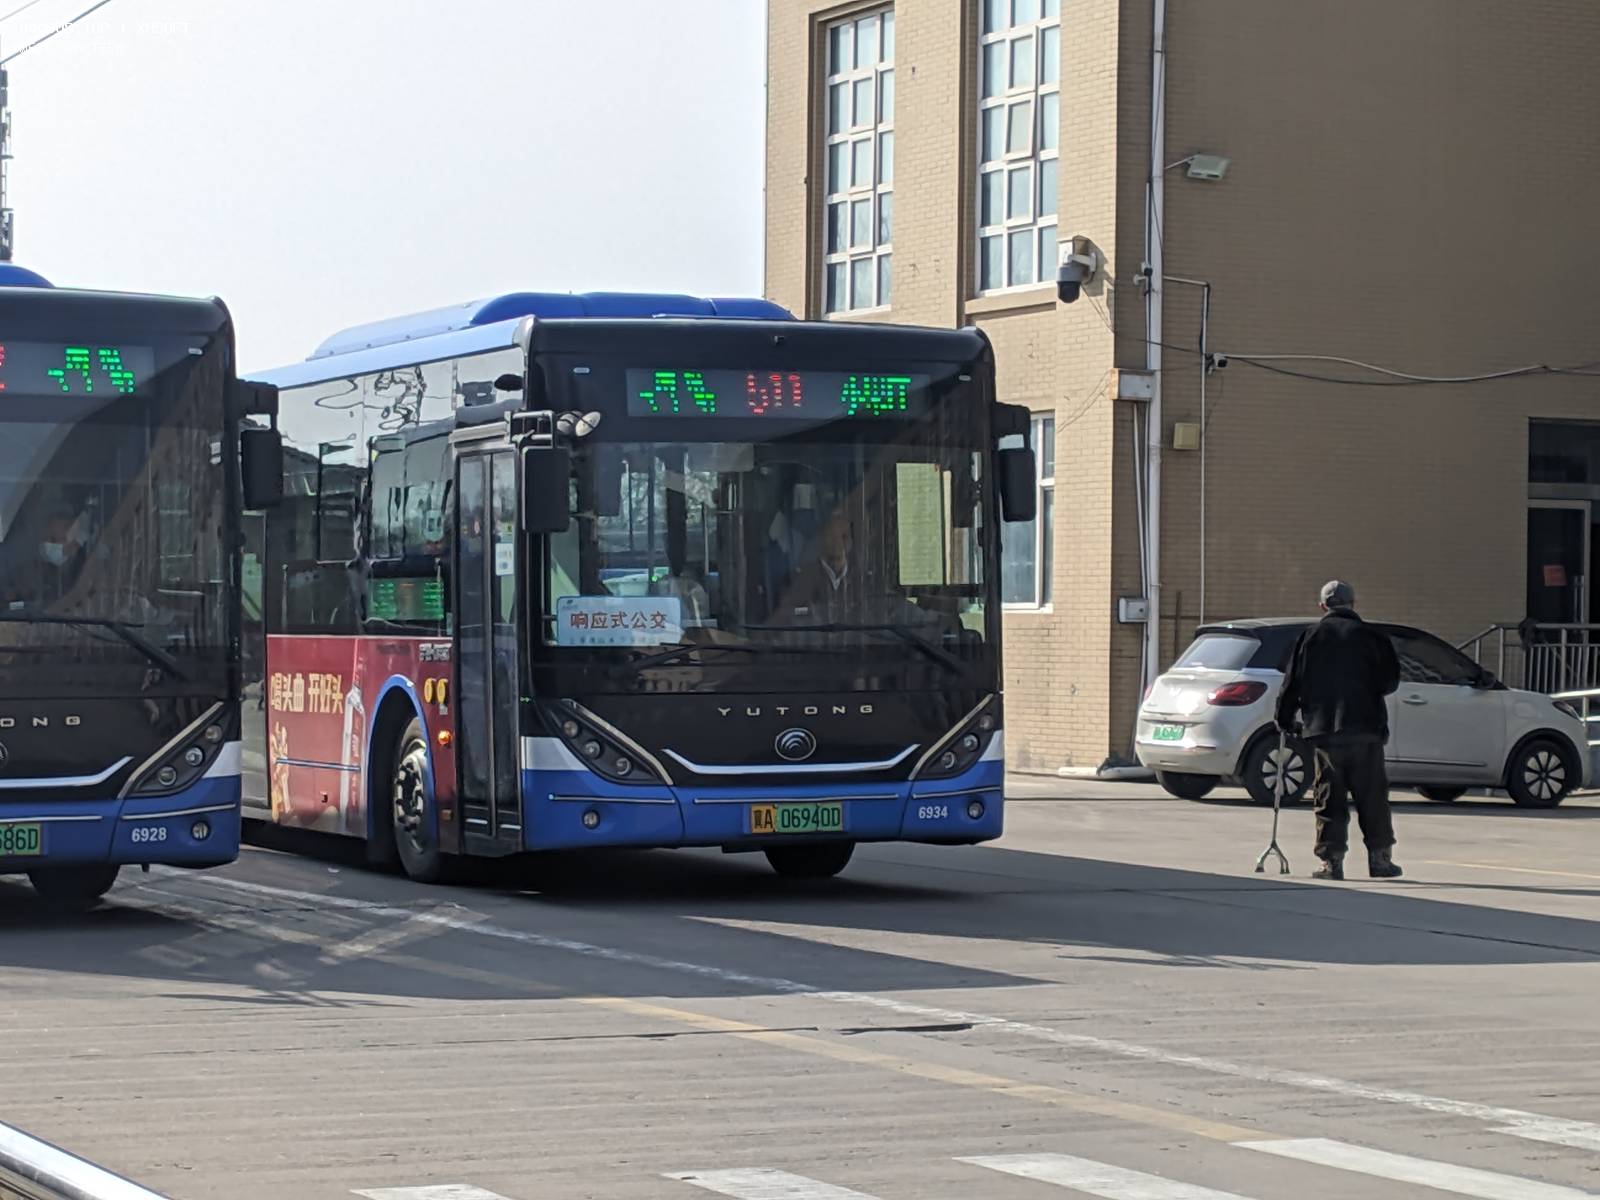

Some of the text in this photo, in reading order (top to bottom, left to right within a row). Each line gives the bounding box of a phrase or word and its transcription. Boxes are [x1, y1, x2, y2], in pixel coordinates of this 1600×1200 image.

[570, 610, 668, 630] 响应式公交
[718, 705, 874, 716] YUTONG
[918, 806, 949, 820] 6934
[0, 828, 39, 850] 86D
[131, 827, 167, 842] 6928
